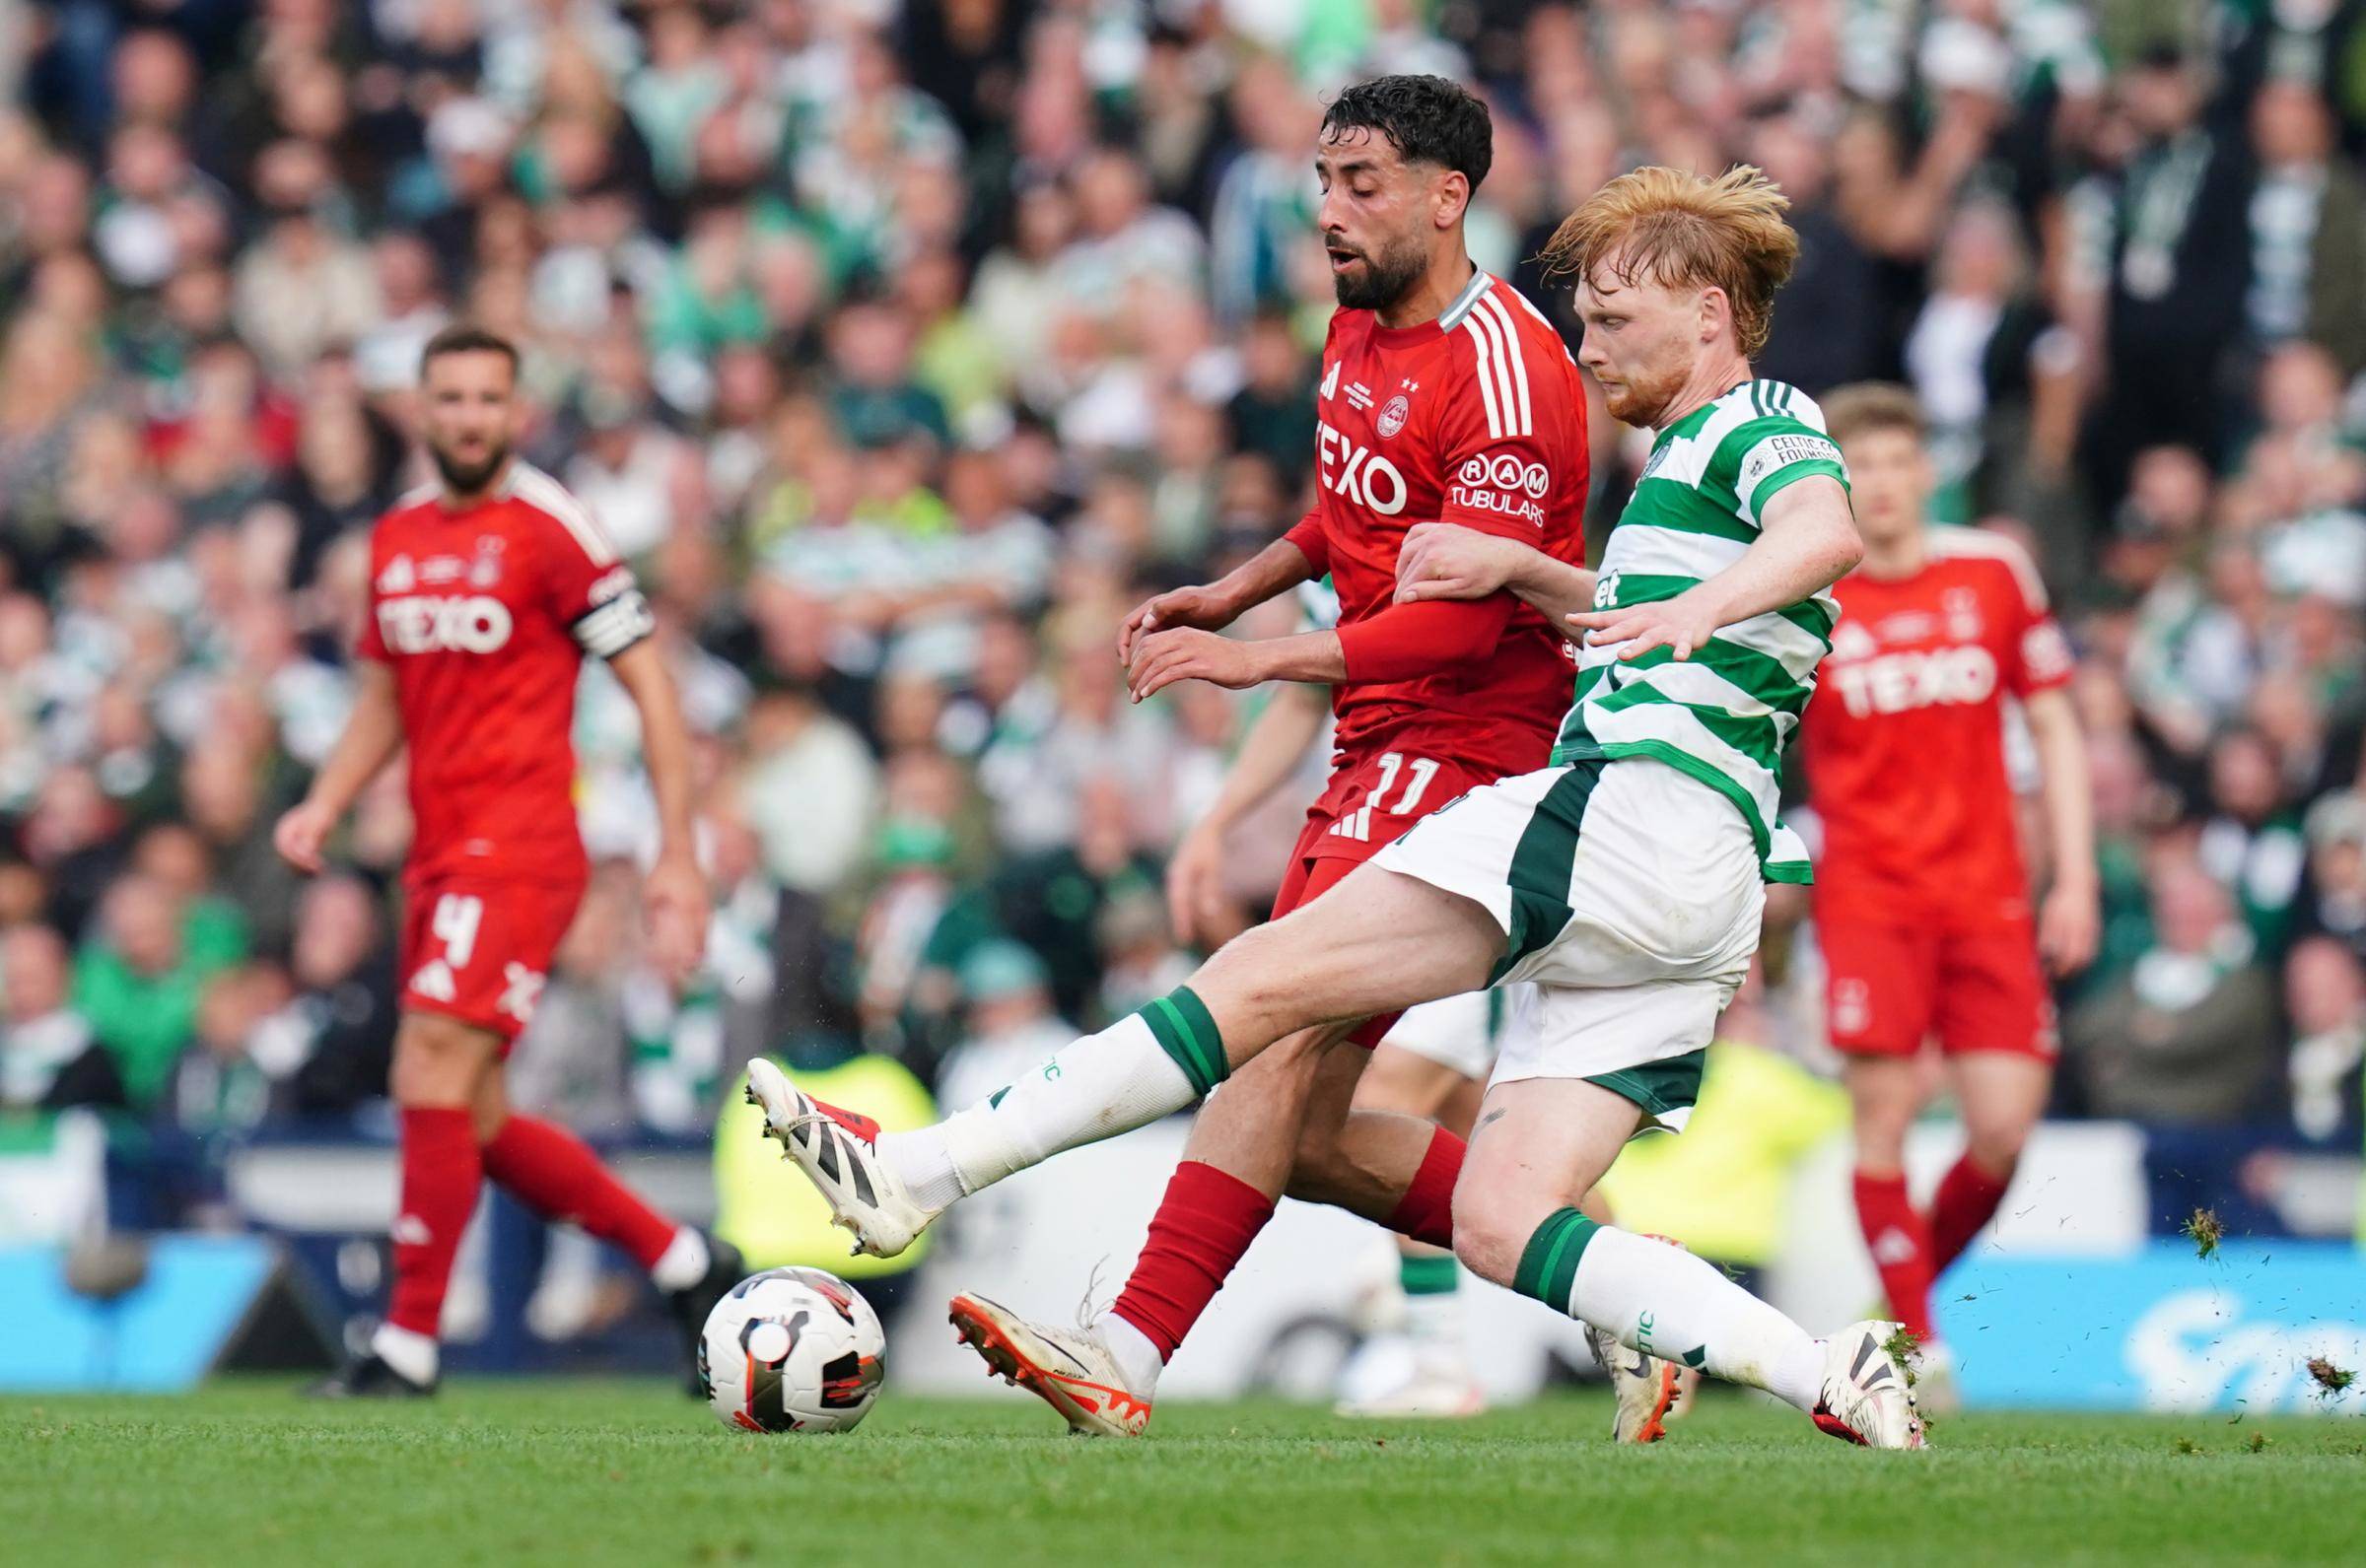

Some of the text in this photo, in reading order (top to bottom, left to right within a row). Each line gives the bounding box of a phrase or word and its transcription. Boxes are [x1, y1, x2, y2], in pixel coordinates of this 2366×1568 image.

[1772, 436, 1816, 450] CELTIC
[1459, 452, 1549, 499] RAM
[1451, 487, 1545, 528] TUBULARS
[1366, 752, 1440, 815] 11
[433, 893, 483, 969] 4
[1041, 1056, 1061, 1082] IC
